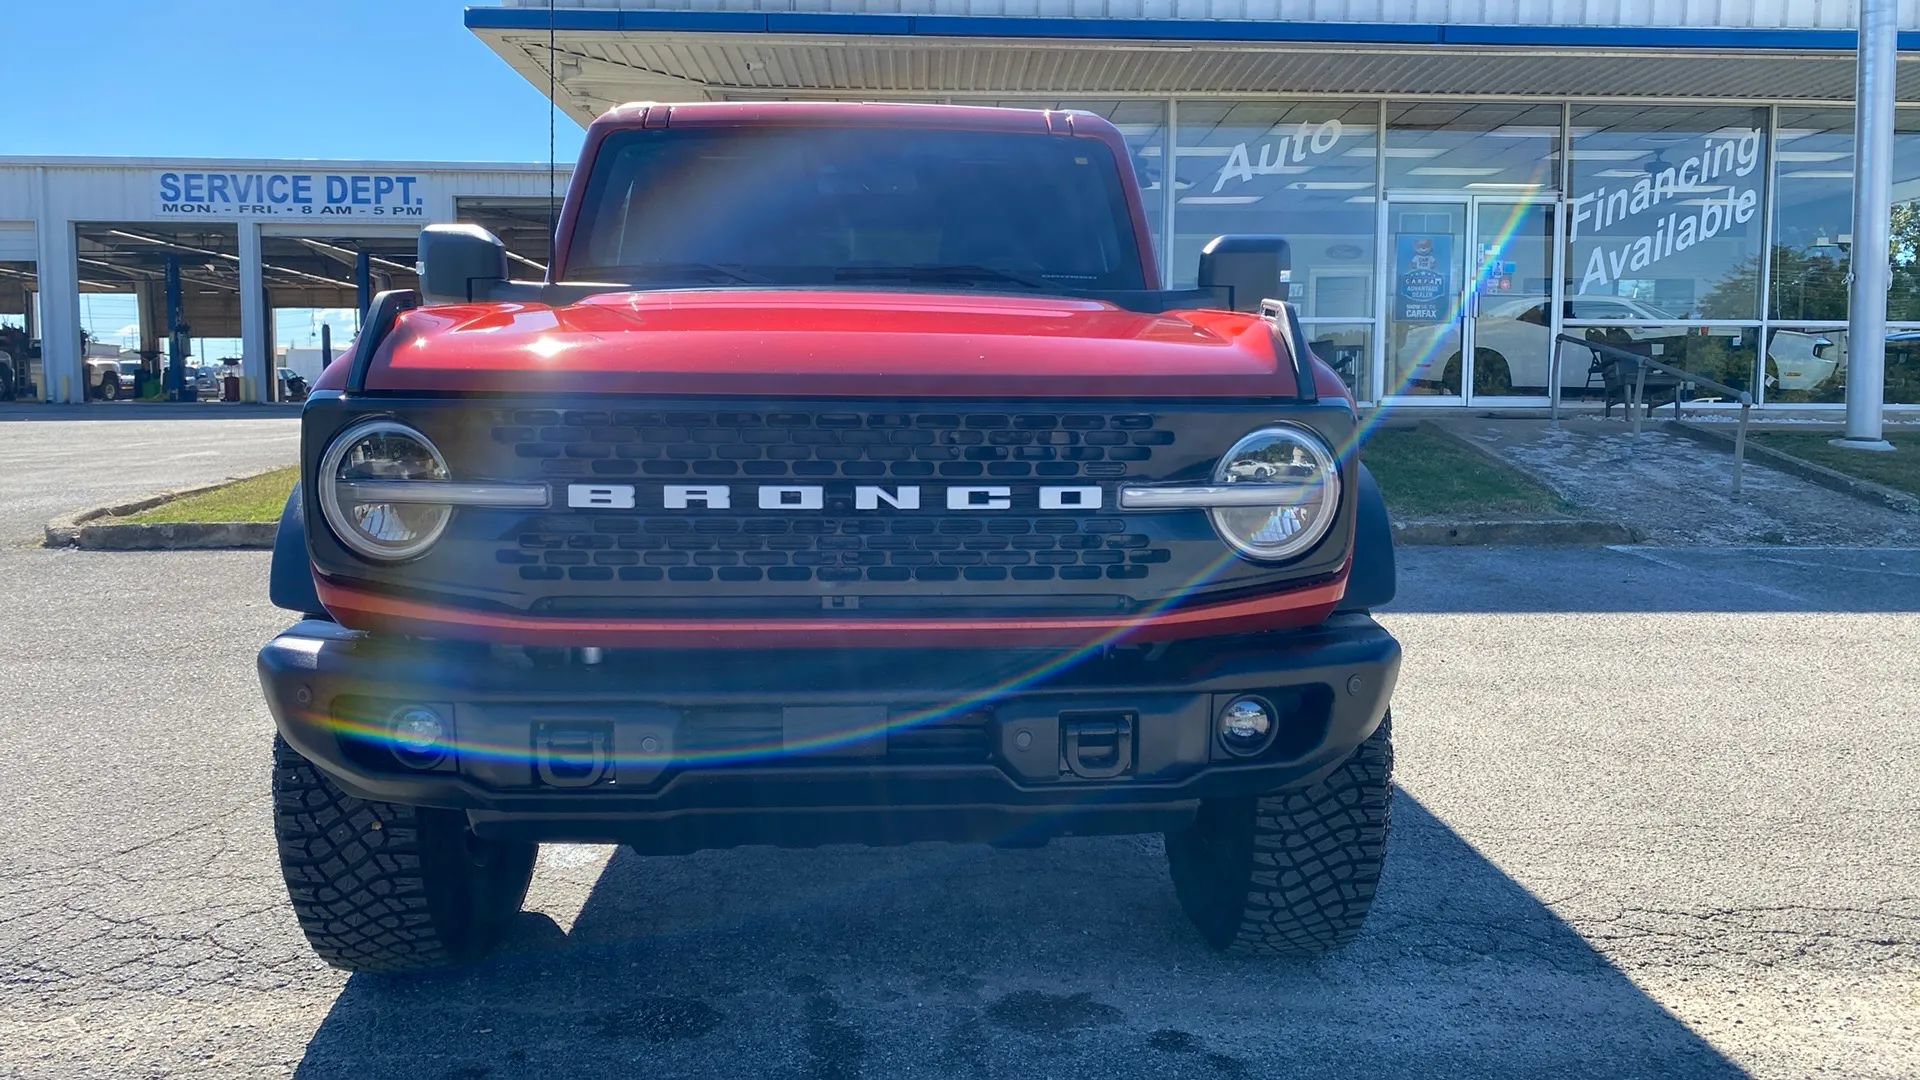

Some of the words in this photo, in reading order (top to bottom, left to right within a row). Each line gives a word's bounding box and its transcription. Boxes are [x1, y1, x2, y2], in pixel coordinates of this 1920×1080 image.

[1212, 119, 1343, 193] Auto
[160, 173, 312, 204] SERVICE
[326, 176, 423, 205] DEPT.
[1570, 128, 1761, 243] Financing
[162, 203, 217, 213] MON.
[239, 204, 279, 214] FRI.
[301, 205, 313, 215] 8
[320, 206, 352, 215] AM
[373, 206, 385, 215] 5
[392, 206, 423, 216] PM
[1578, 186, 1757, 296] Available
[1406, 310, 1437, 318] CARFAX
[568, 485, 1102, 509] BRONCO
